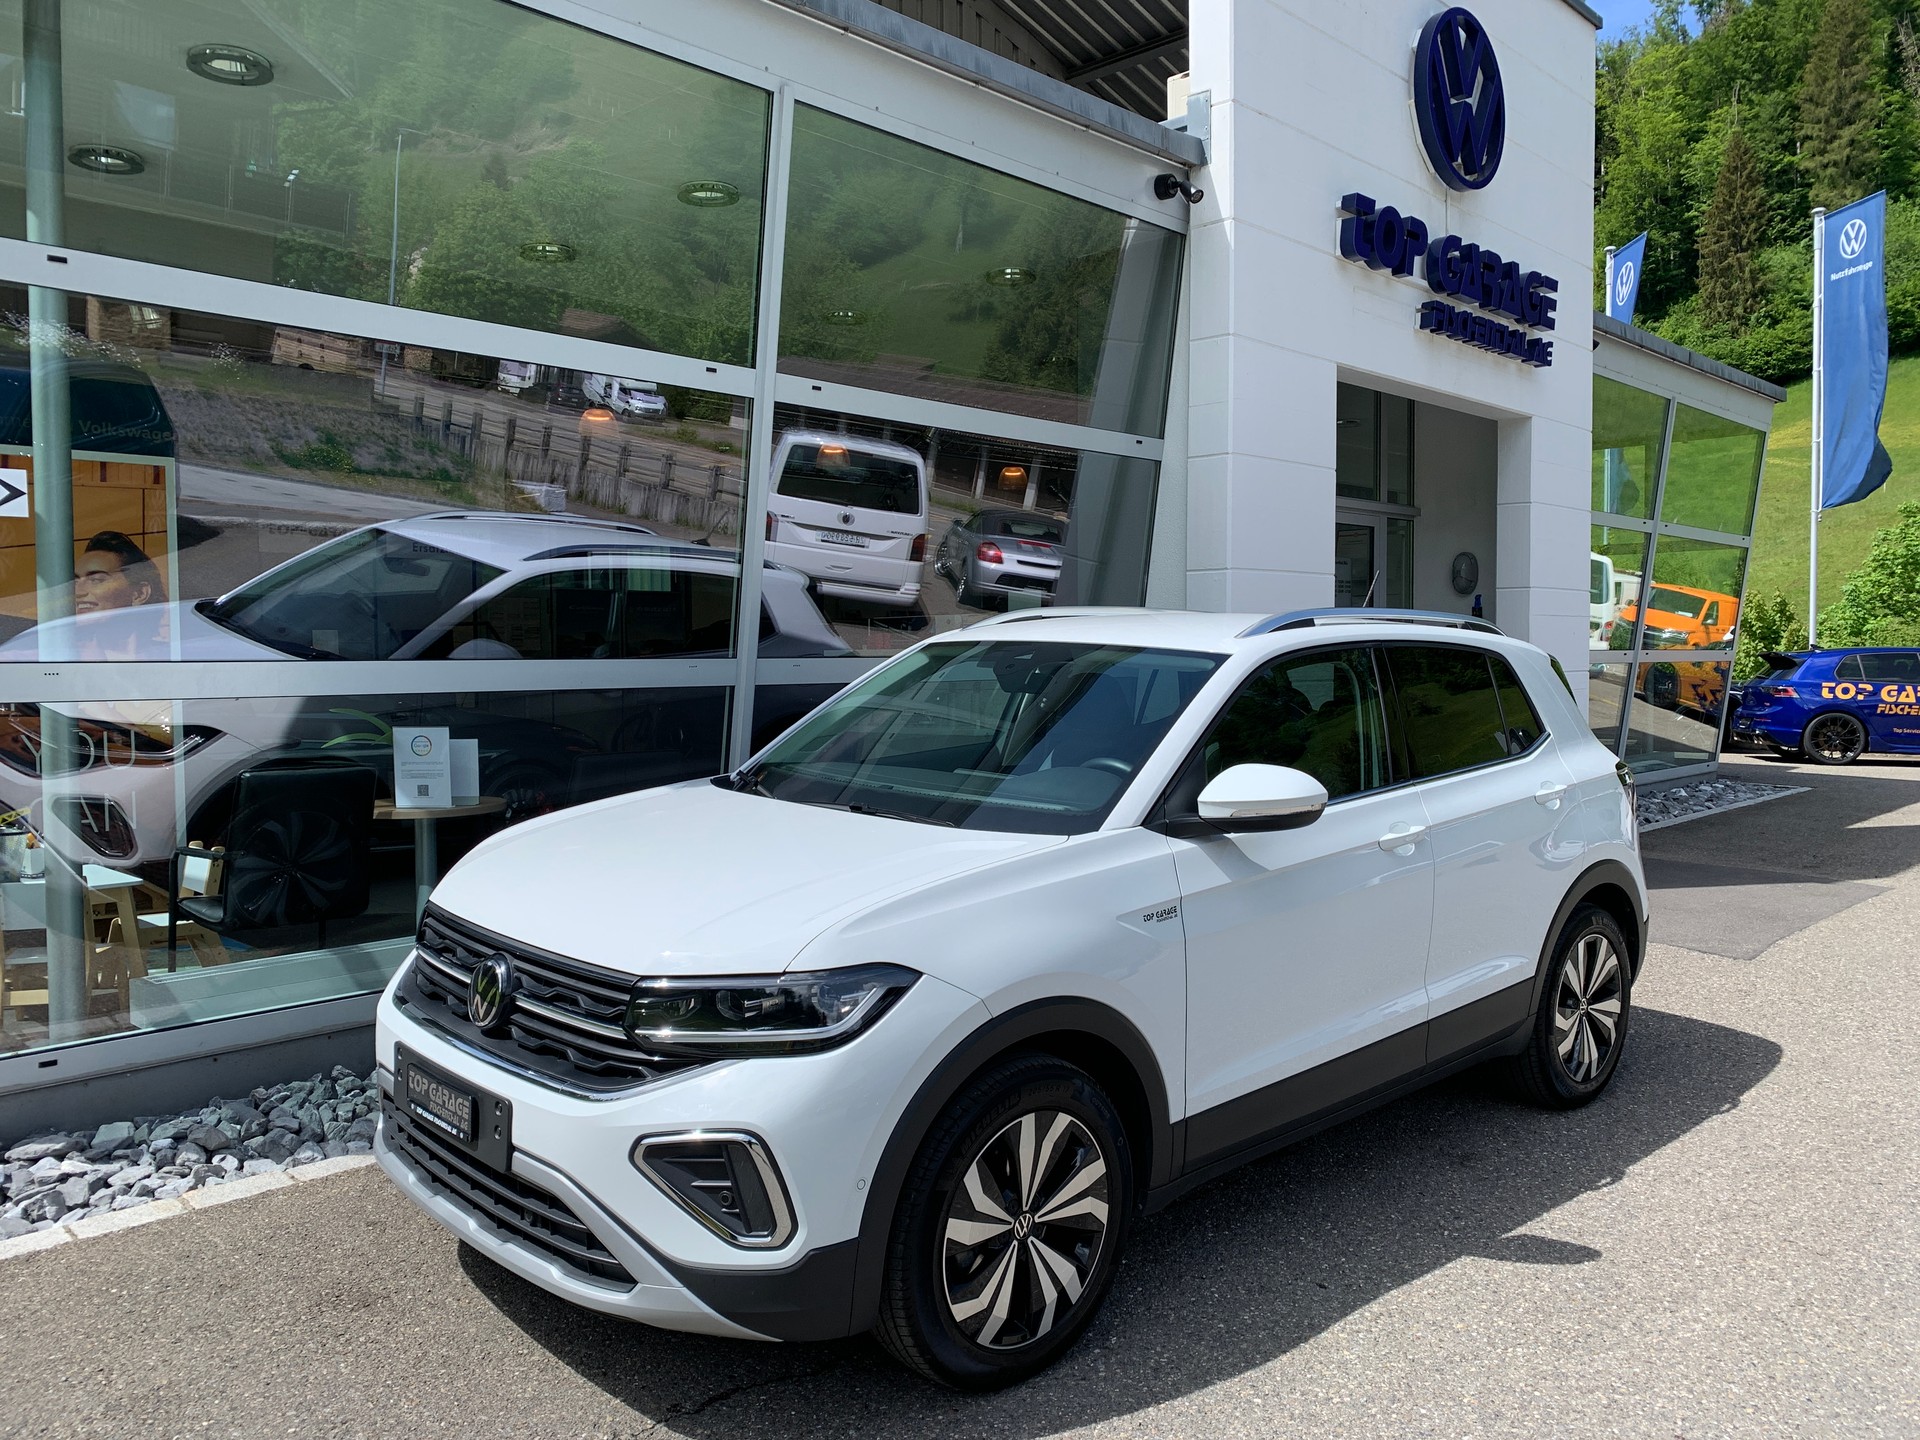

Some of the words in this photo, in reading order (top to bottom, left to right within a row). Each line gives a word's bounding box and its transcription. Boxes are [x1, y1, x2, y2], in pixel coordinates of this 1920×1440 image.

[1426, 235, 1558, 332] GARAGE
[1880, 685, 1920, 703] GA
[1876, 704, 1920, 716] FISCHE
[1155, 905, 1178, 918] GARAGE
[408, 1070, 428, 1095] TOP
[429, 1083, 470, 1119] GARAGE
